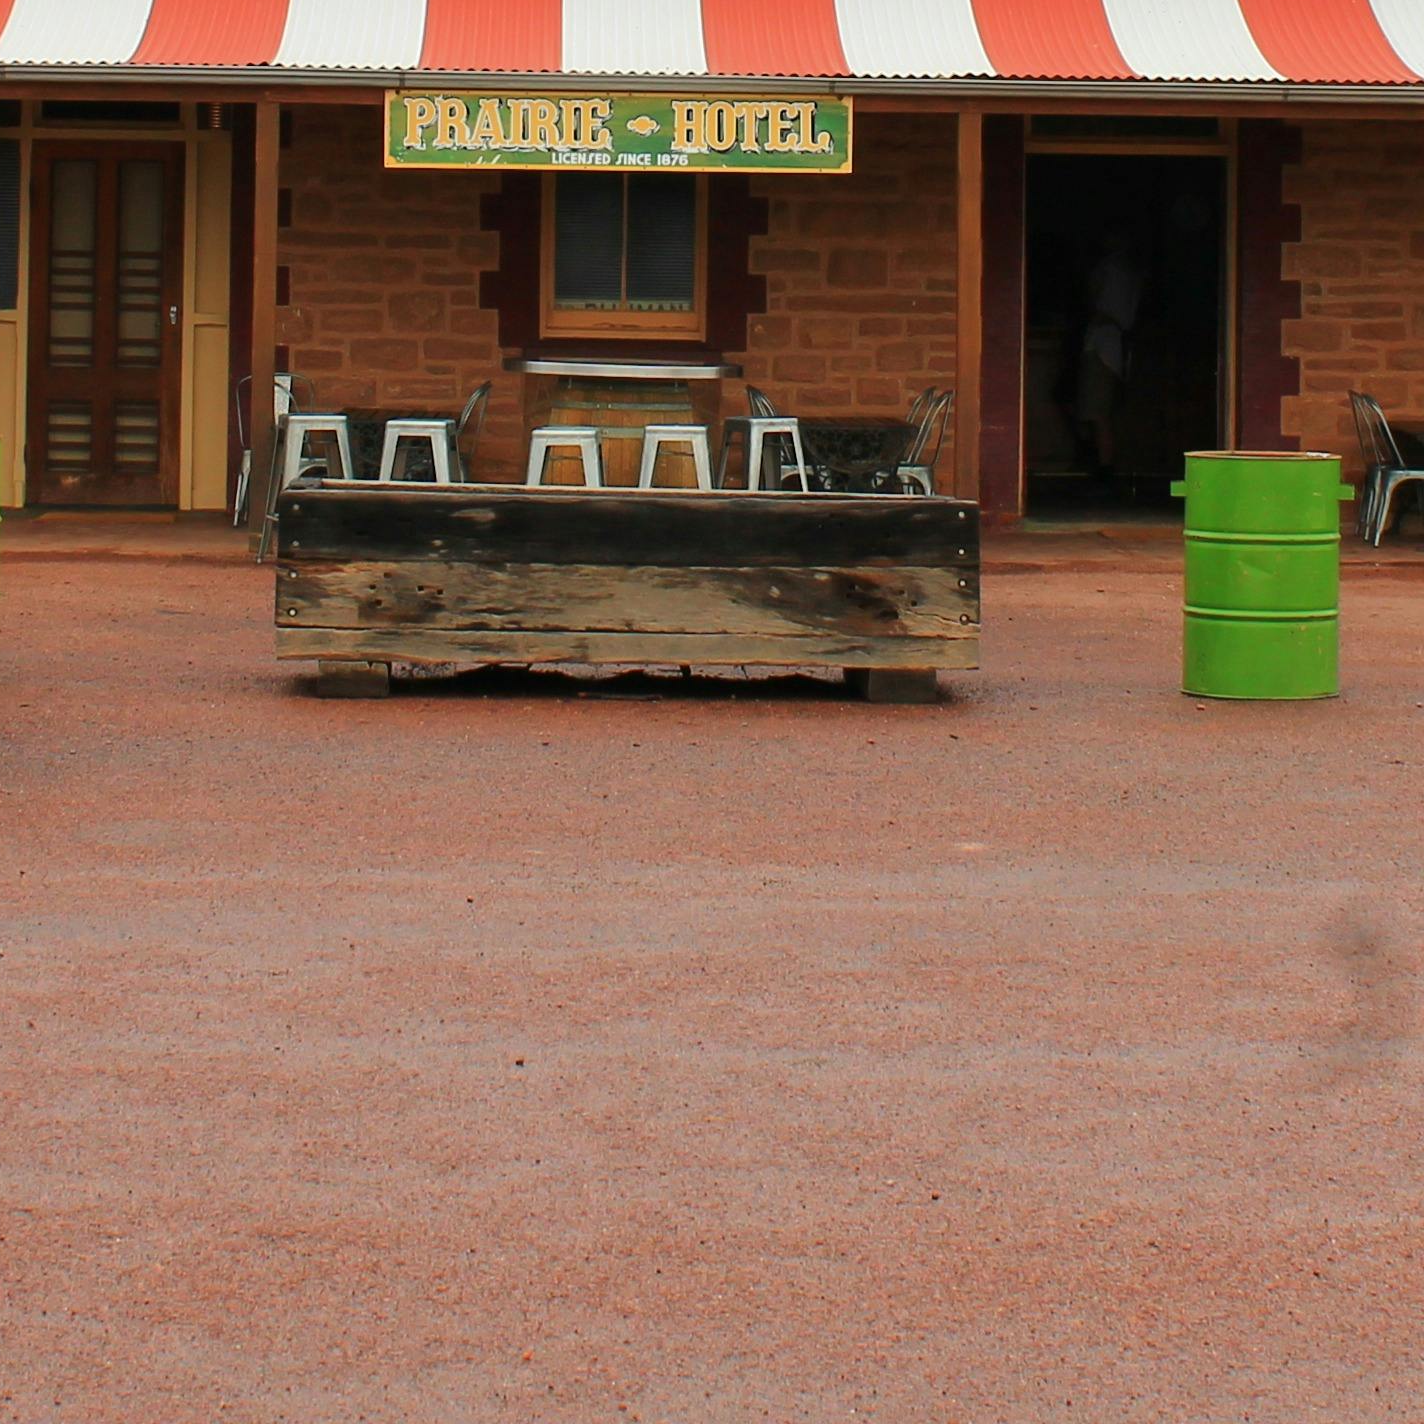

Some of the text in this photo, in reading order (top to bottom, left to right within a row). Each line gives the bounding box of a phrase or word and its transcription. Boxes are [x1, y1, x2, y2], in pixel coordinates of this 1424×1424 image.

[403, 96, 833, 154] PRAIRIE HOTEL
[551, 152, 689, 166] LICENSED SINCE 1876
